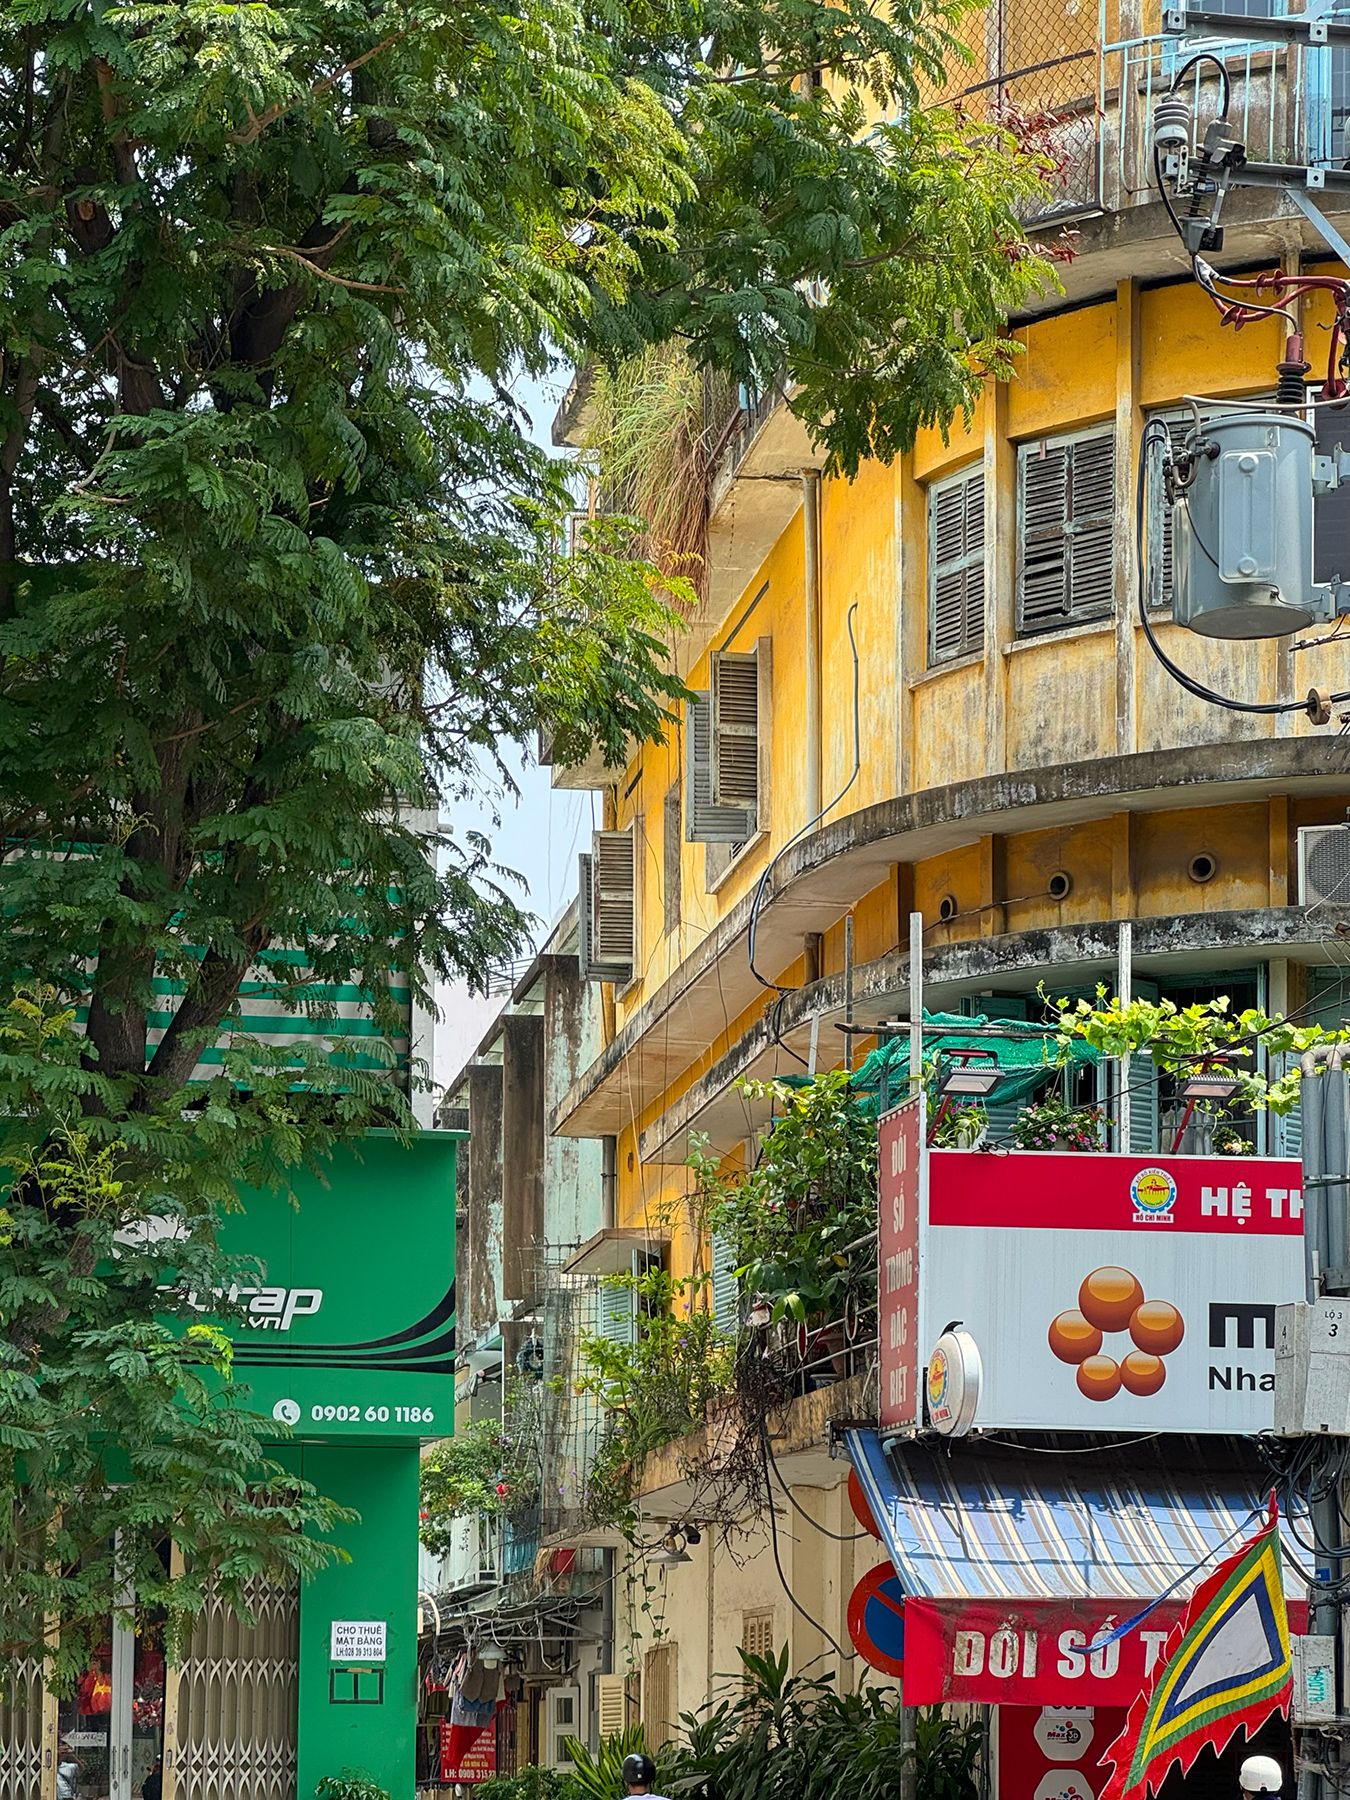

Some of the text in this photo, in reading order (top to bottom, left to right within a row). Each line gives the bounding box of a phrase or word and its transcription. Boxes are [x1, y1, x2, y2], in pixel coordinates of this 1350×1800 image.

[893, 1181, 905, 1234] SỐ
[1201, 1181, 1252, 1225] HỆ
[885, 1247, 913, 1294] TRÚNG
[890, 1304, 907, 1355] ĐẶC
[1328, 1324, 1339, 1337] 3
[889, 1359, 908, 1411] BIỆT
[311, 1405, 434, 1423] 0902 60 1186
[336, 1626, 356, 1635] CHO
[952, 1614, 1037, 1678] ĐỔI
[1057, 1614, 1120, 1678] SỐ
[444, 1768, 457, 1779] LH:
